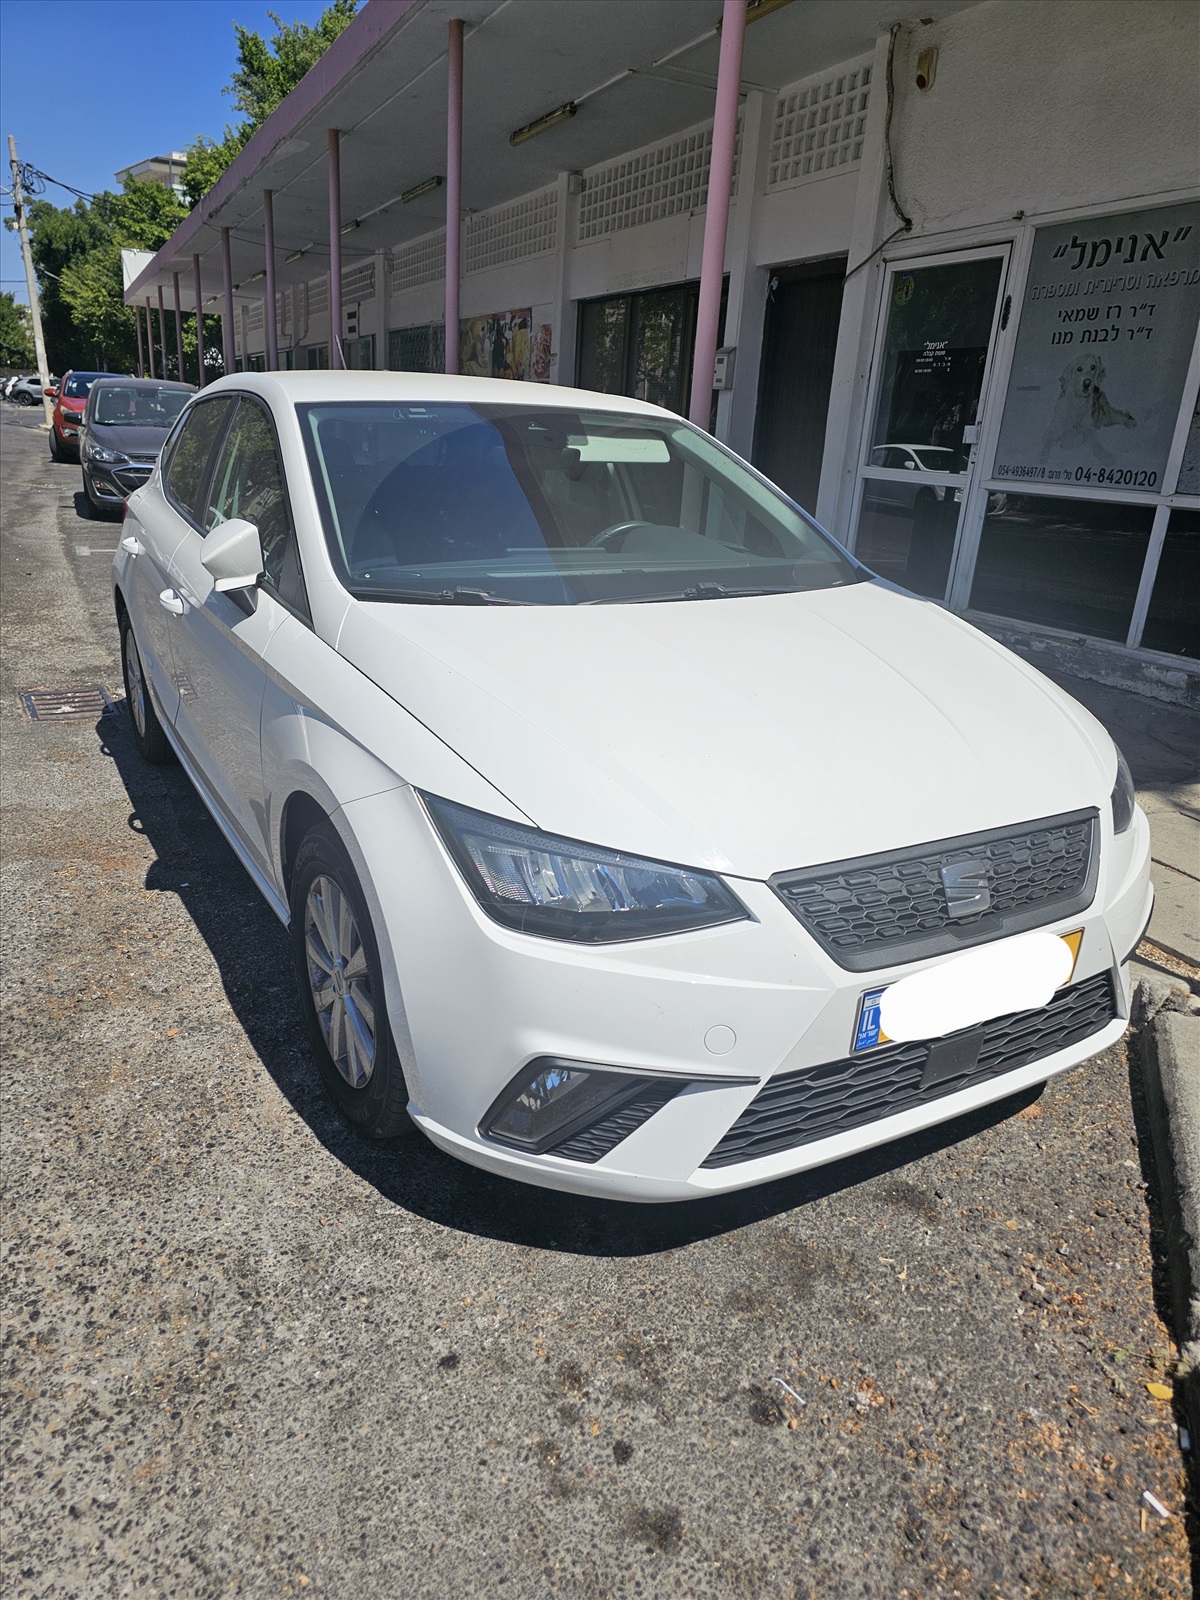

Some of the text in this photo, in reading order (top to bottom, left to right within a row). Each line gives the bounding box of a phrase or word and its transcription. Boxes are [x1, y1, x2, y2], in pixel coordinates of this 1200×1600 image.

[1031, 282, 1081, 300] ומספרה
[1057, 306, 1100, 323] שמאי
[1105, 304, 1122, 319] רז
[1051, 332, 1073, 345] מנו
[1079, 324, 1120, 344] לבנת
[1075, 466, 1157, 487] 04-8420120
[862, 1009, 876, 1032] IL
